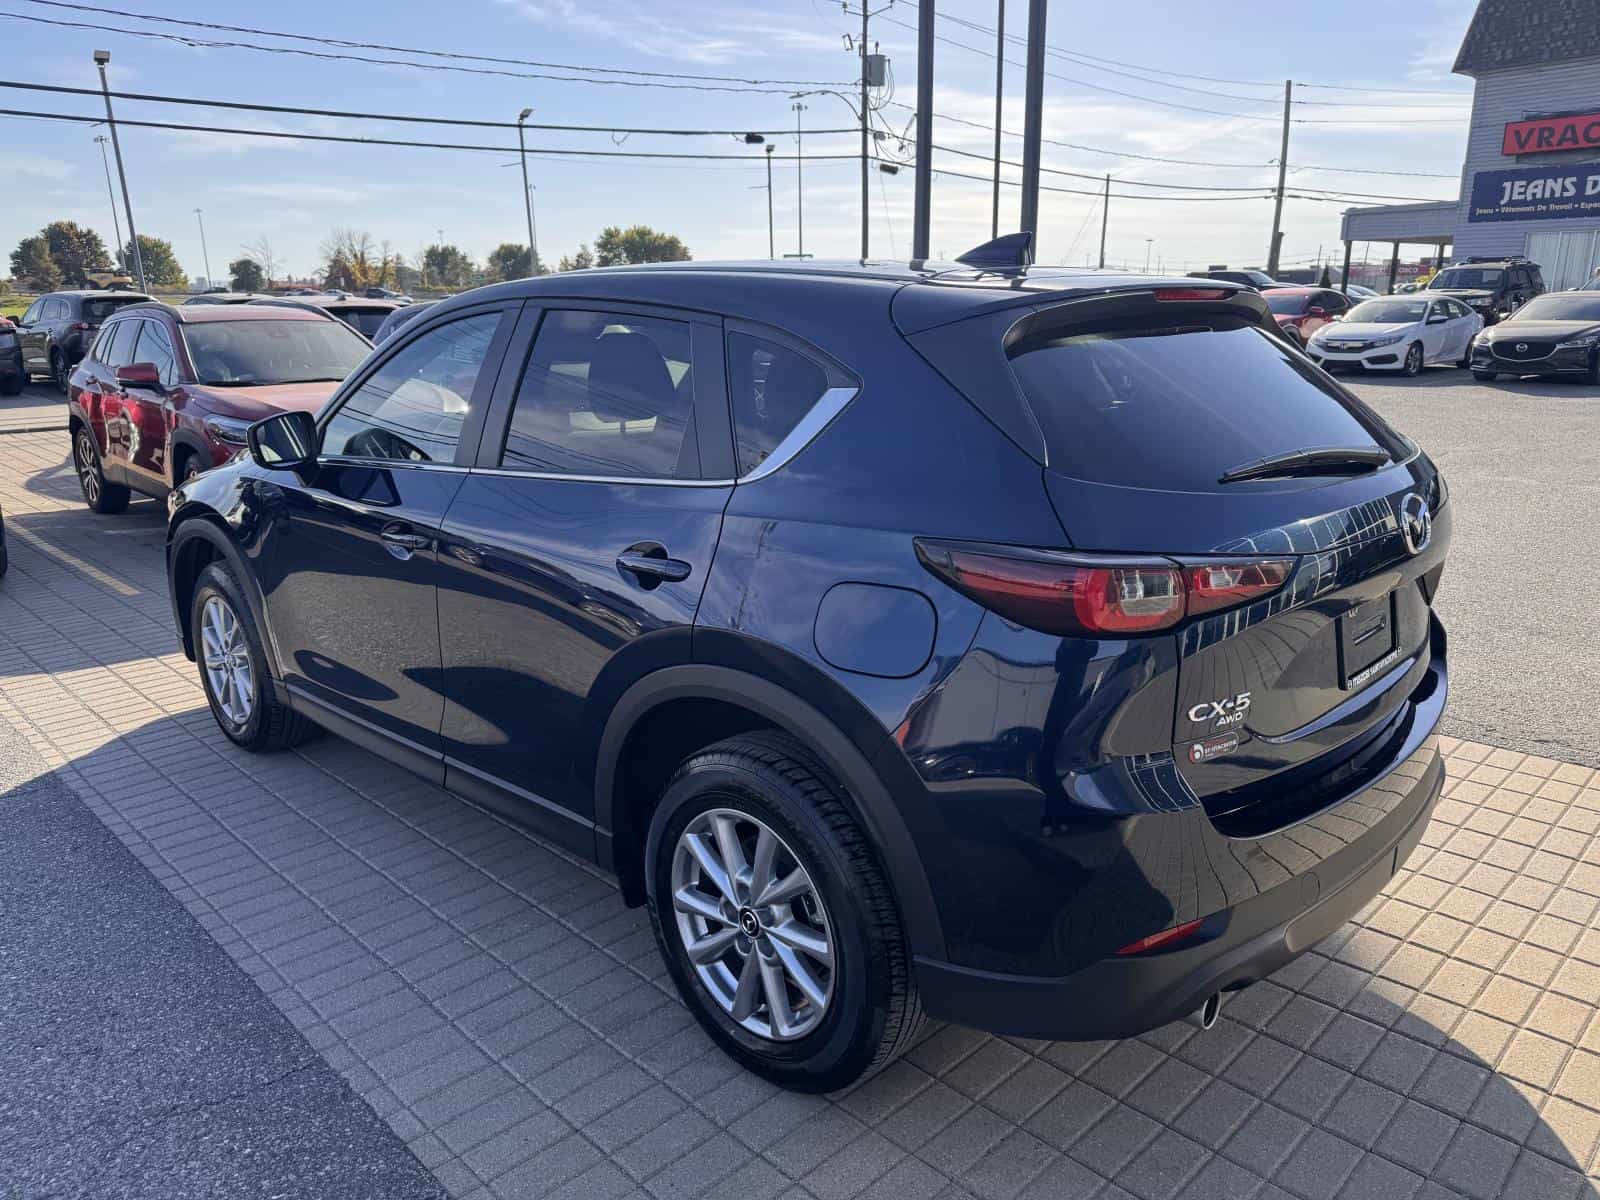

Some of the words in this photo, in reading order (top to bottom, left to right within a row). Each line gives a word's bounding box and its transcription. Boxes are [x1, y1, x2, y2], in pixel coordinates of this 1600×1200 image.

[1500, 176, 1577, 205] JEANS
[1188, 692, 1251, 722] CX-5
[1216, 712, 1243, 726] AWD
